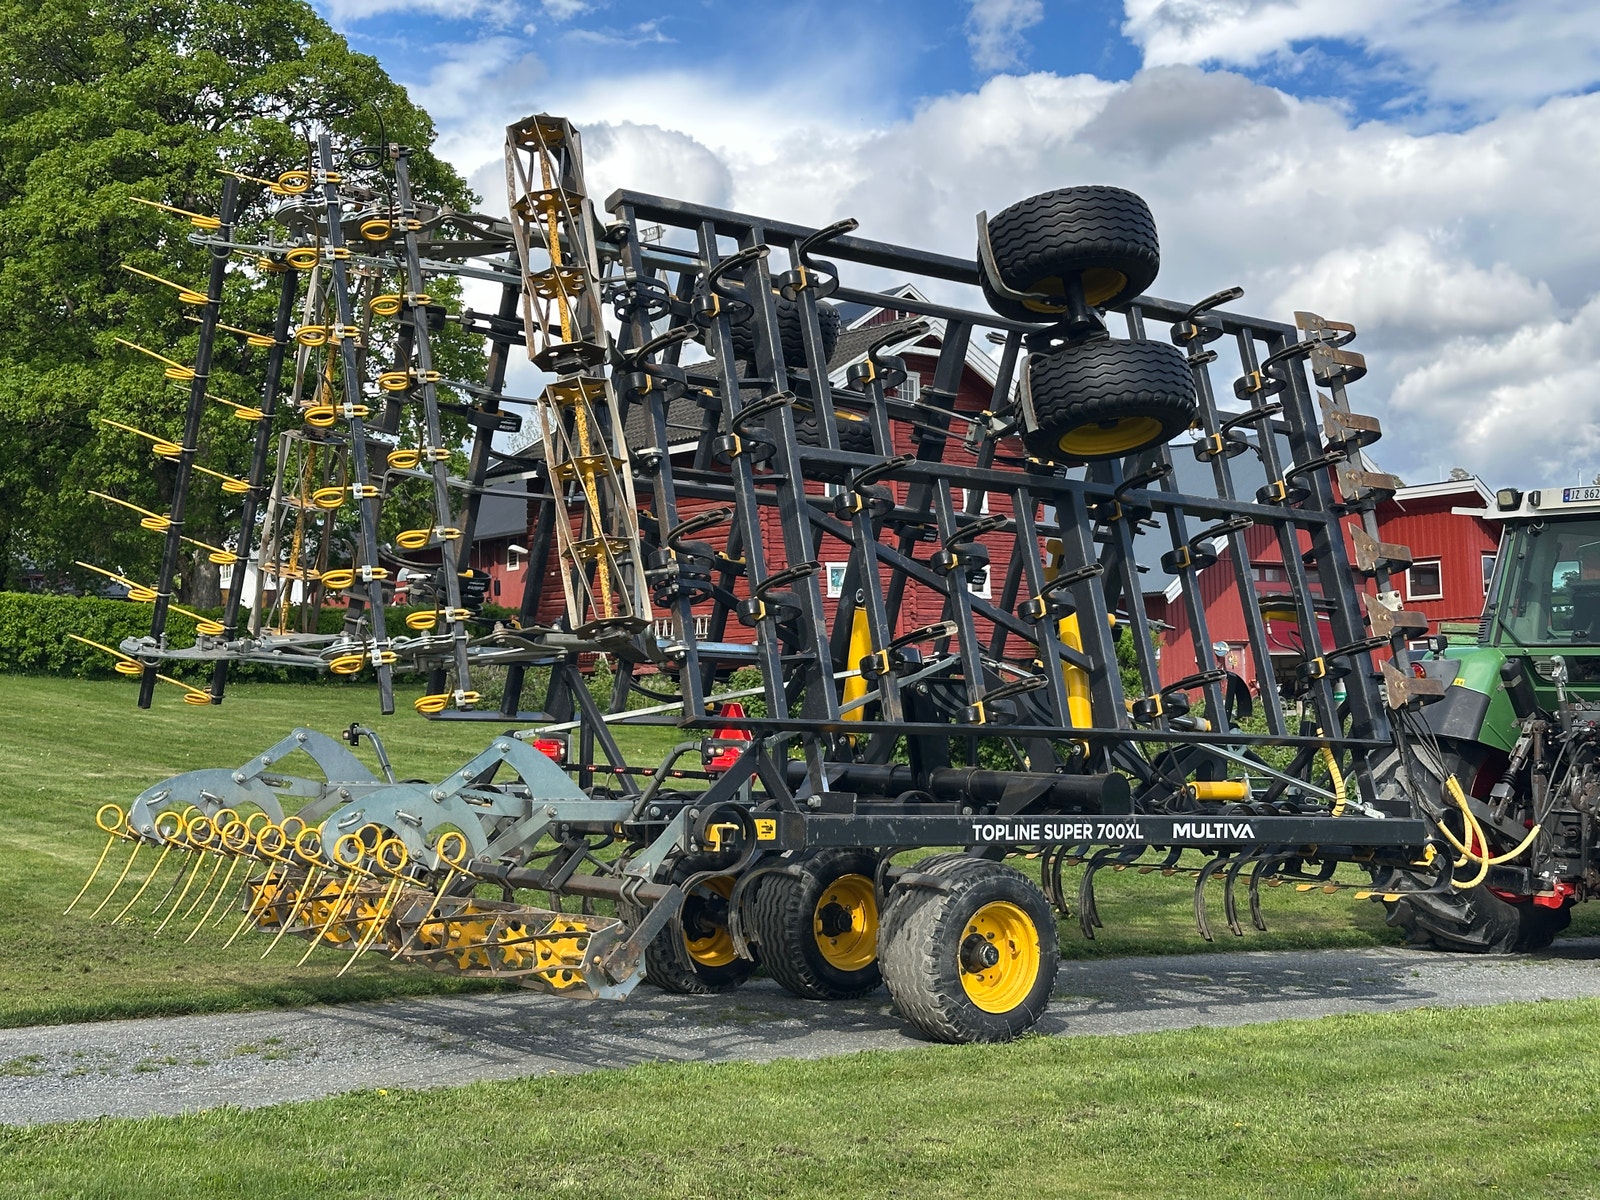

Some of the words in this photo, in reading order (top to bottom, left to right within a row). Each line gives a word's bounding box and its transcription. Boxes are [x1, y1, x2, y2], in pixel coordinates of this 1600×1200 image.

[1571, 490, 1580, 499] JZ
[971, 824, 1041, 841] TOPLINE
[1043, 823, 1093, 840] SUPER
[1096, 823, 1145, 840] 700XL
[1172, 822, 1256, 839] MULTIVA
